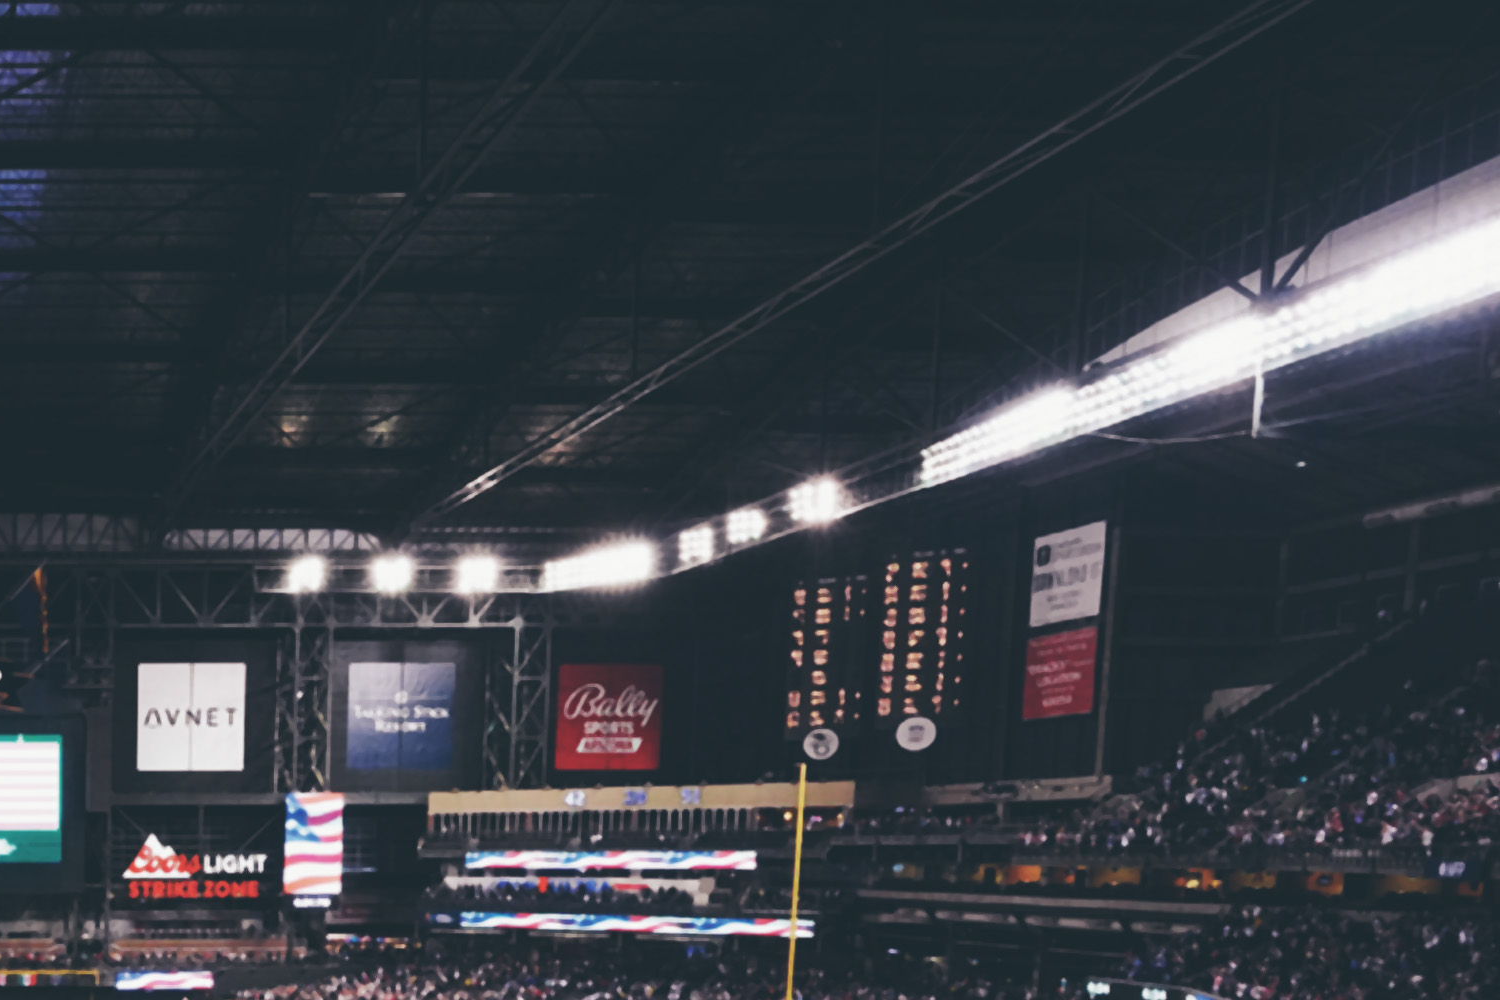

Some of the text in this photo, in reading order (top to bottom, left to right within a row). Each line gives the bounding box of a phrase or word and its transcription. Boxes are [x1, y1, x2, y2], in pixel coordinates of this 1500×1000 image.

[563, 683, 658, 727] Bally
[143, 707, 237, 728] AVNET
[203, 853, 268, 875] LIGHT
[128, 879, 260, 899] STRIKE ZONE
